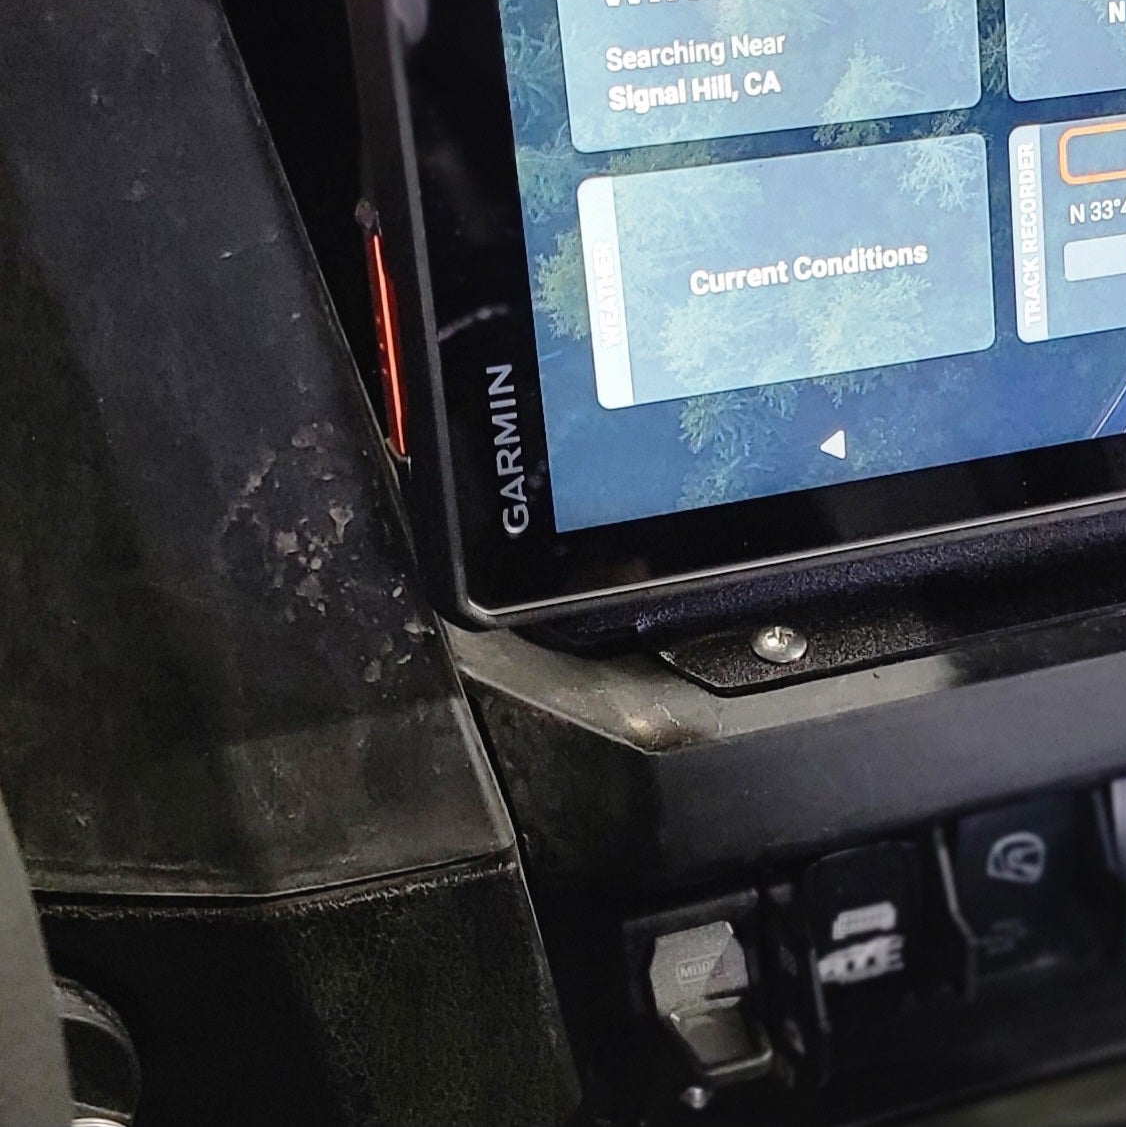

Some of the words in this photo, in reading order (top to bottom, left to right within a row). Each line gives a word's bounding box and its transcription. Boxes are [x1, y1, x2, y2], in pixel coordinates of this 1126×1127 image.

[1107, 0, 1126, 24] N
[605, 39, 725, 72] Searching
[730, 33, 786, 59] Near
[607, 78, 686, 114] Signal
[691, 73, 739, 103] Hill,
[743, 69, 782, 96] CA
[1017, 141, 1039, 255] RECORDER
[1069, 203, 1086, 224] N
[593, 240, 622, 348] WEATHER
[689, 260, 789, 296] Current
[792, 243, 929, 281] Conditions
[1022, 256, 1043, 330] TRACK
[486, 364, 530, 536] GARMIN
